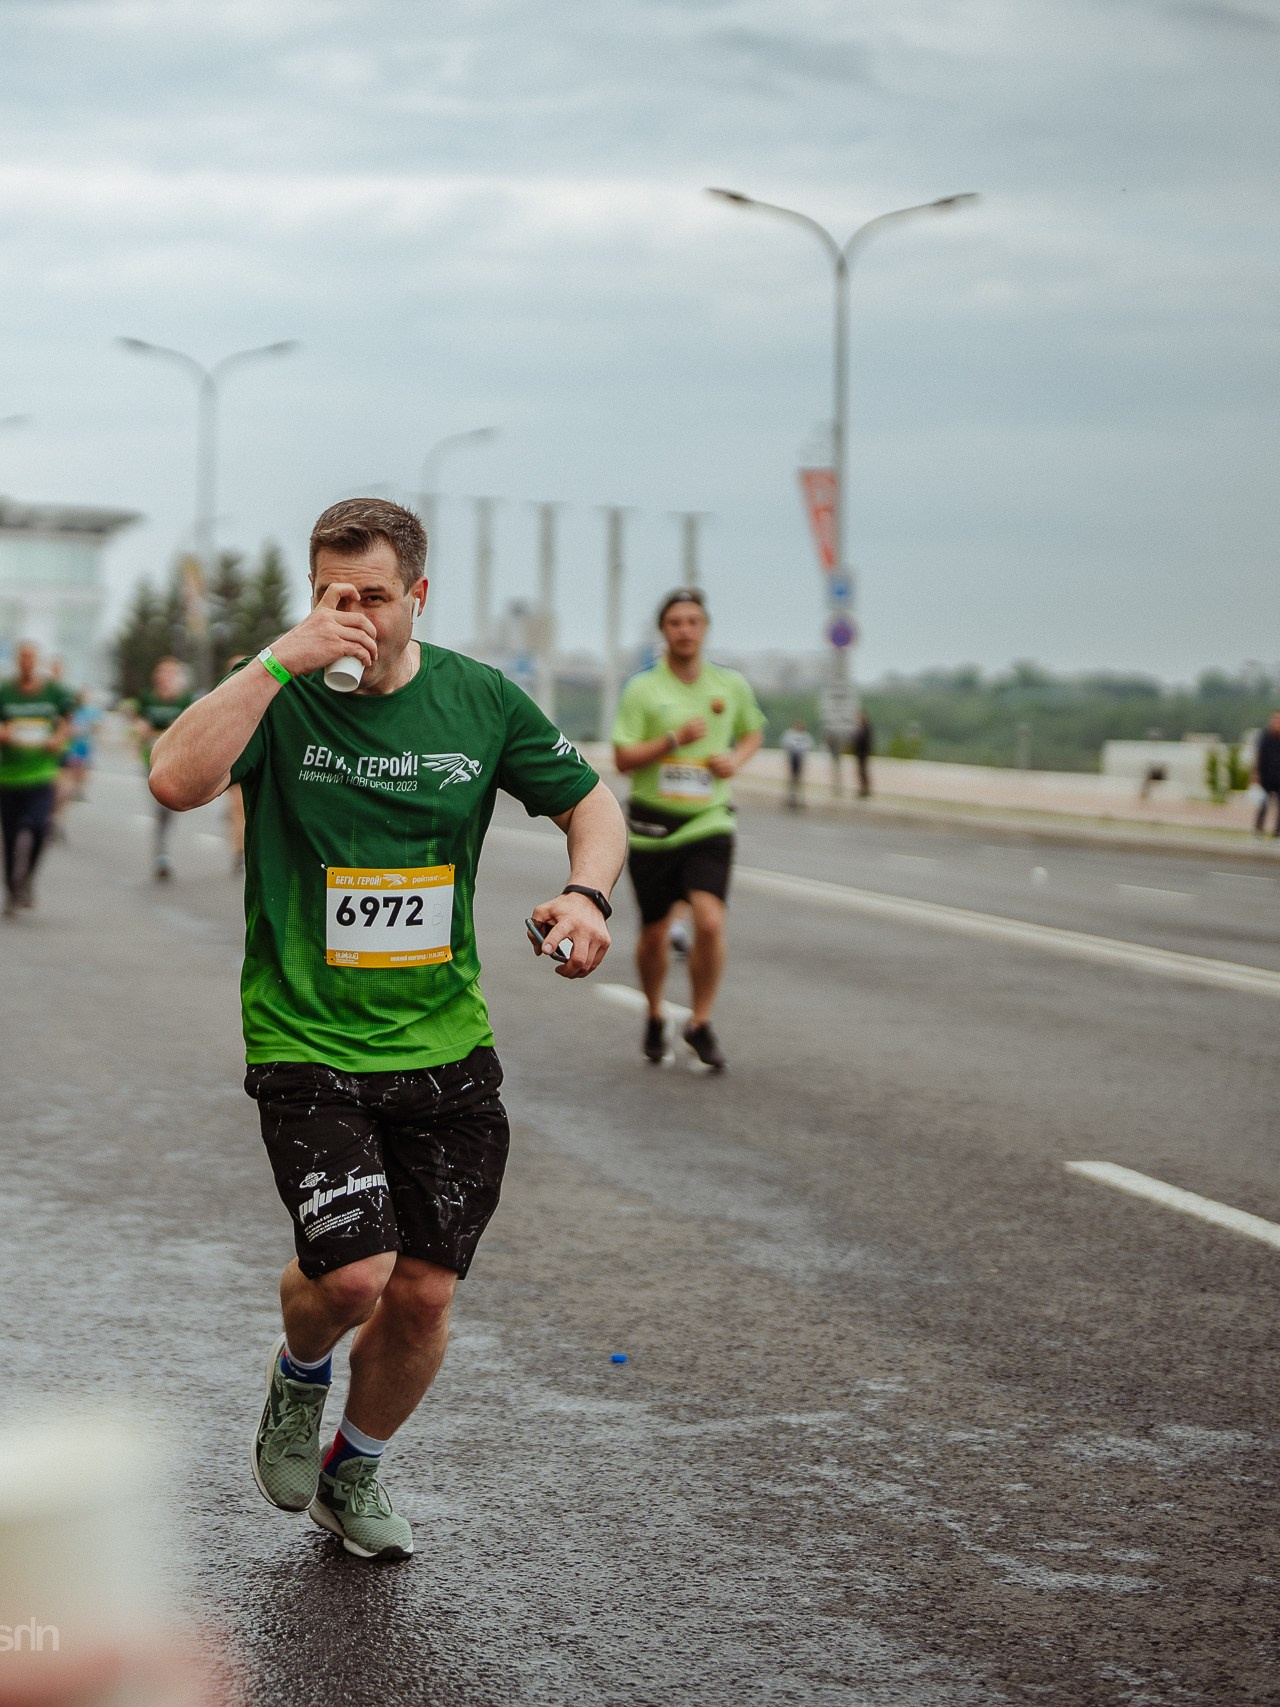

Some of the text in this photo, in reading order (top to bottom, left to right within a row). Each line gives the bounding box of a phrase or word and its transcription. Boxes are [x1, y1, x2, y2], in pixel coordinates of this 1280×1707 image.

[357, 751, 418, 777] ГЕРОЙ!
[298, 770, 344, 783] НИЖНИЙ
[396, 781, 418, 791] 2023
[336, 895, 424, 927] 6972
